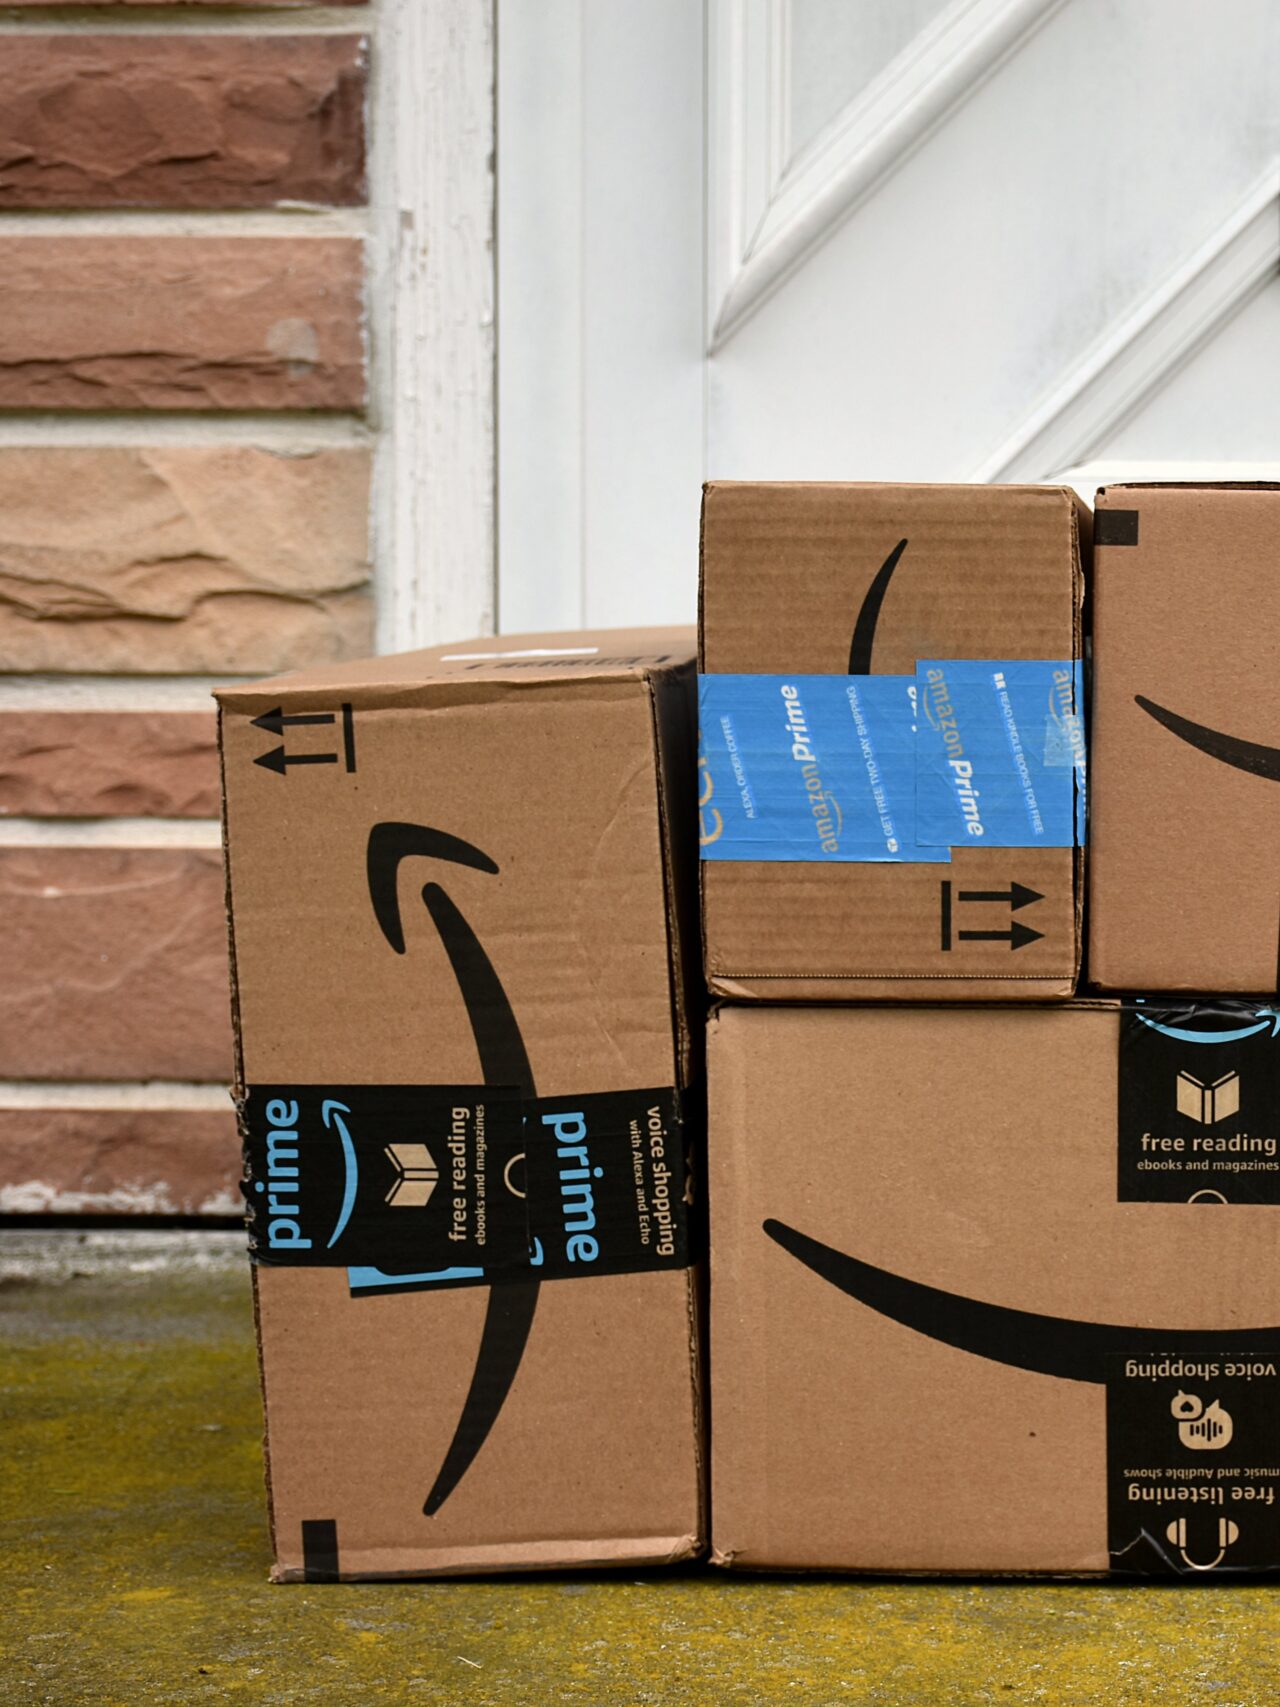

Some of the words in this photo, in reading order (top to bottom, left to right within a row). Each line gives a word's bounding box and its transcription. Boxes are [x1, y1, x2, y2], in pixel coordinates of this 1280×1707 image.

[846, 685, 867, 736] SHIPPING
[999, 690, 1012, 717] READ
[720, 716, 736, 752] COFFEE
[780, 684, 816, 761] Prime
[1006, 718, 1021, 752] KINDLE
[859, 737, 879, 785] TWO-DAY
[926, 668, 963, 758] amazon
[948, 759, 983, 836] Prime
[730, 752, 745, 786] ORDER
[1015, 752, 1031, 787] BOOKS
[801, 763, 838, 852] amazon
[873, 786, 887, 813] FREE
[1024, 788, 1037, 808] FOR
[880, 815, 893, 836] GET
[1030, 809, 1043, 833] FREE
[473, 1105, 487, 1171] magazines
[629, 1119, 641, 1149] with
[647, 1106, 667, 1158] voice
[1141, 1133, 1185, 1151] free
[1193, 1133, 1277, 1156] reading
[448, 1107, 470, 1190] reading
[255, 1099, 312, 1249] prime
[632, 1151, 645, 1185] Alexa
[1137, 1159, 1182, 1170] ebooks
[1185, 1159, 1209, 1170] and
[1212, 1160, 1280, 1173] magazines
[474, 1174, 486, 1198] and
[542, 1111, 604, 1262] prime
[636, 1188, 649, 1212] and
[448, 1198, 467, 1241] free
[474, 1201, 486, 1245] ebooks
[651, 1163, 677, 1256] shopping
[639, 1215, 650, 1245] Echo
[1125, 1359, 1220, 1382] shopping
[1224, 1363, 1276, 1381] voice
[1123, 1468, 1163, 1478] shows
[1165, 1467, 1213, 1480] Audible
[1217, 1468, 1241, 1479] and
[1243, 1468, 1280, 1479] music
[1128, 1483, 1224, 1505] listening
[1231, 1487, 1275, 1505] free
